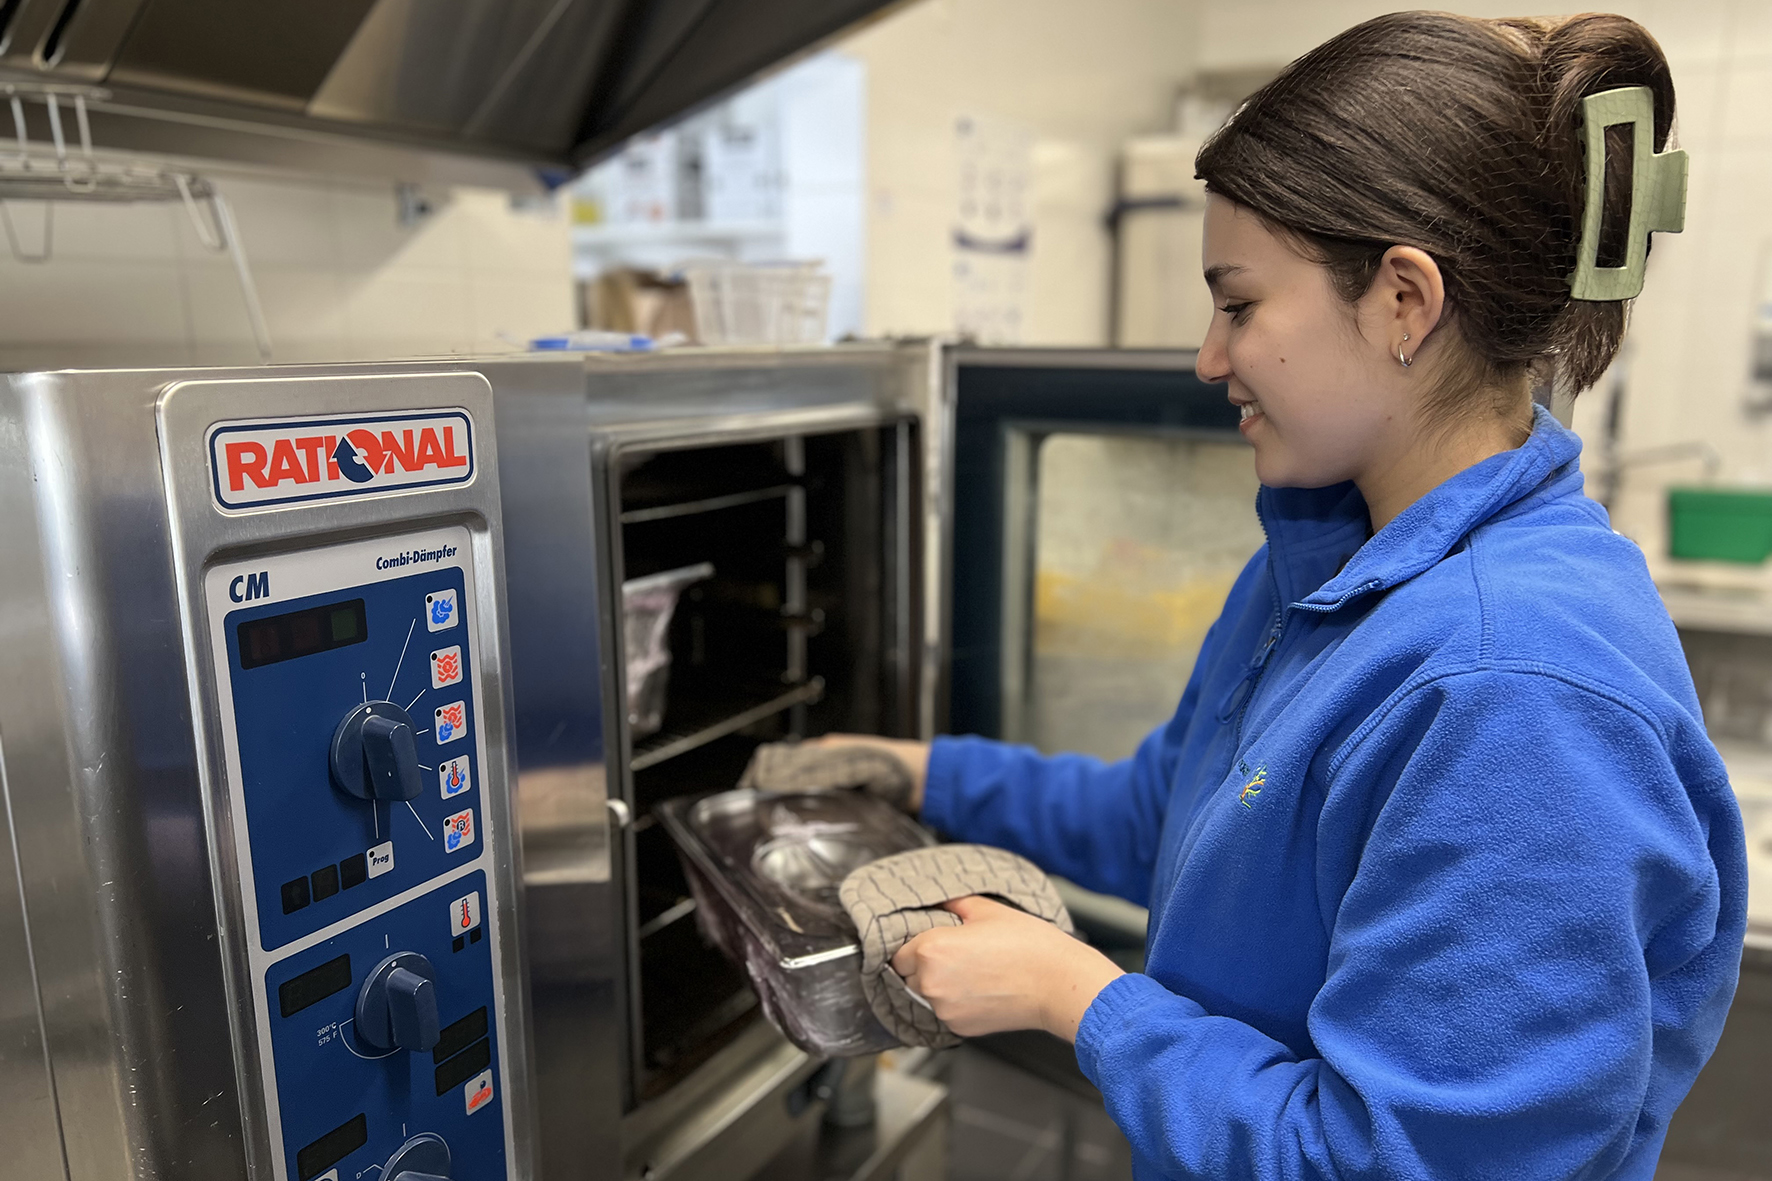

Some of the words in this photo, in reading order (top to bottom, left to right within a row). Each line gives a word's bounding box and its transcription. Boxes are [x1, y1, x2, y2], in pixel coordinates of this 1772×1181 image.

[225, 426, 467, 491] RATIONAL
[376, 545, 458, 571] Combi-Dämpfer
[229, 571, 270, 603] CM
[372, 854, 389, 866] Prog
